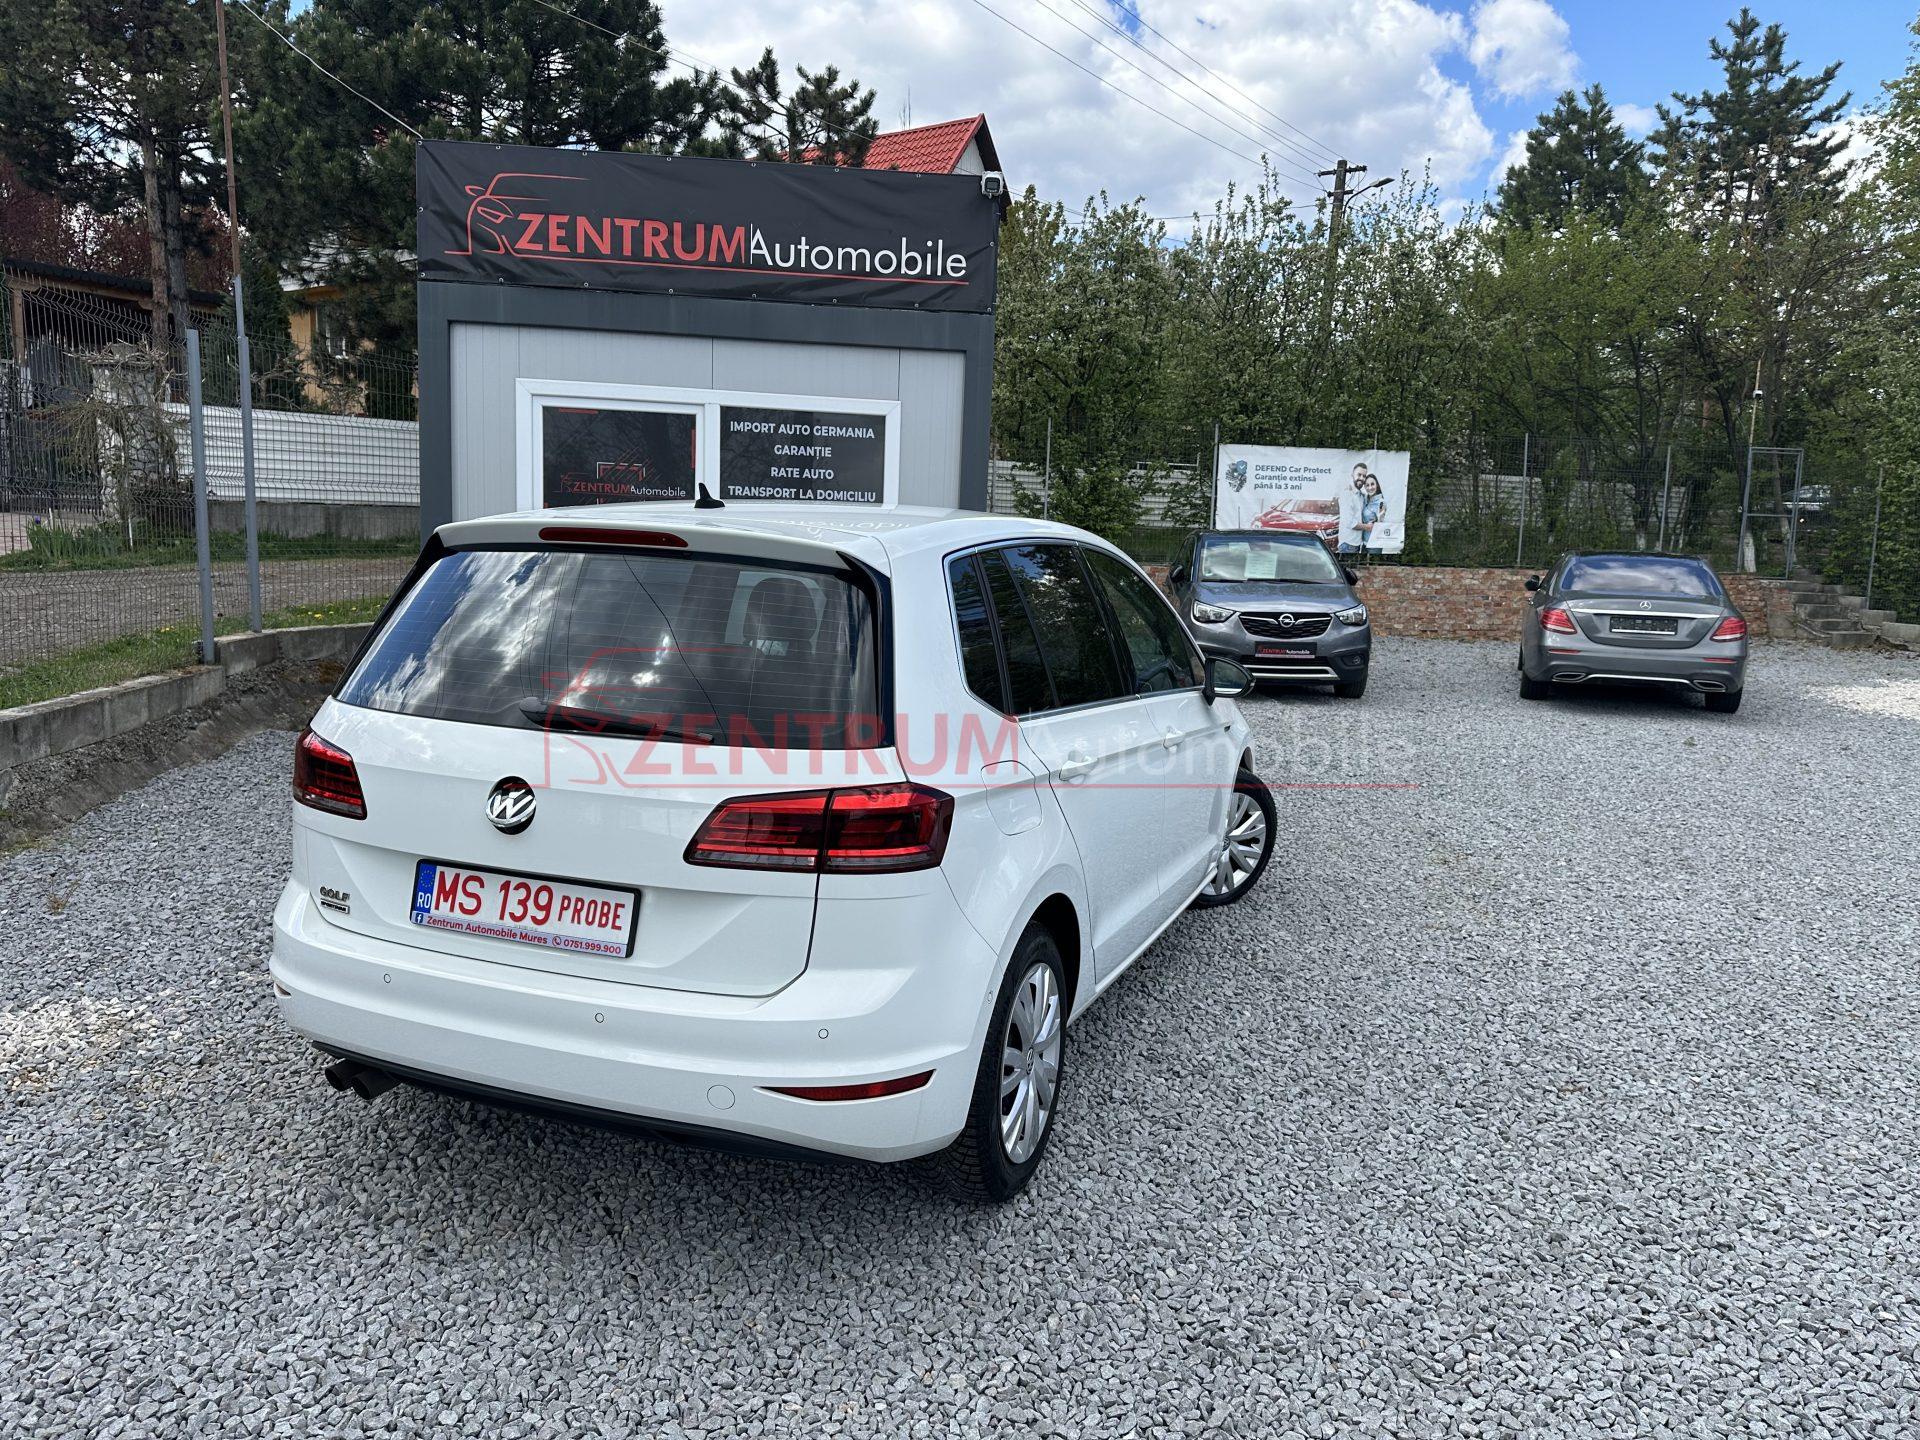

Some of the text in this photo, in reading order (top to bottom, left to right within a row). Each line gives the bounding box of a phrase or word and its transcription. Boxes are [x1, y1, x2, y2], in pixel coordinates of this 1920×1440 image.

[514, 212, 967, 278] ZENTRUM Automobile
[730, 421, 875, 439] IMPORT AUTO GERMANIA
[774, 444, 832, 460] GARANȚIE
[770, 466, 835, 480] RATE AUTO
[1255, 464, 1288, 472] DEFEND
[1303, 466, 1332, 474] Protect
[573, 480, 687, 497] ZENTRUM Automobile
[728, 485, 876, 502] TRANSPORT LA DOMICILIU
[320, 886, 350, 902] GOLF
[416, 891, 432, 909] RO
[434, 871, 626, 931] MS 139 PROBE
[427, 916, 622, 955] Zentrum Automobile Mures 0751.999.900
